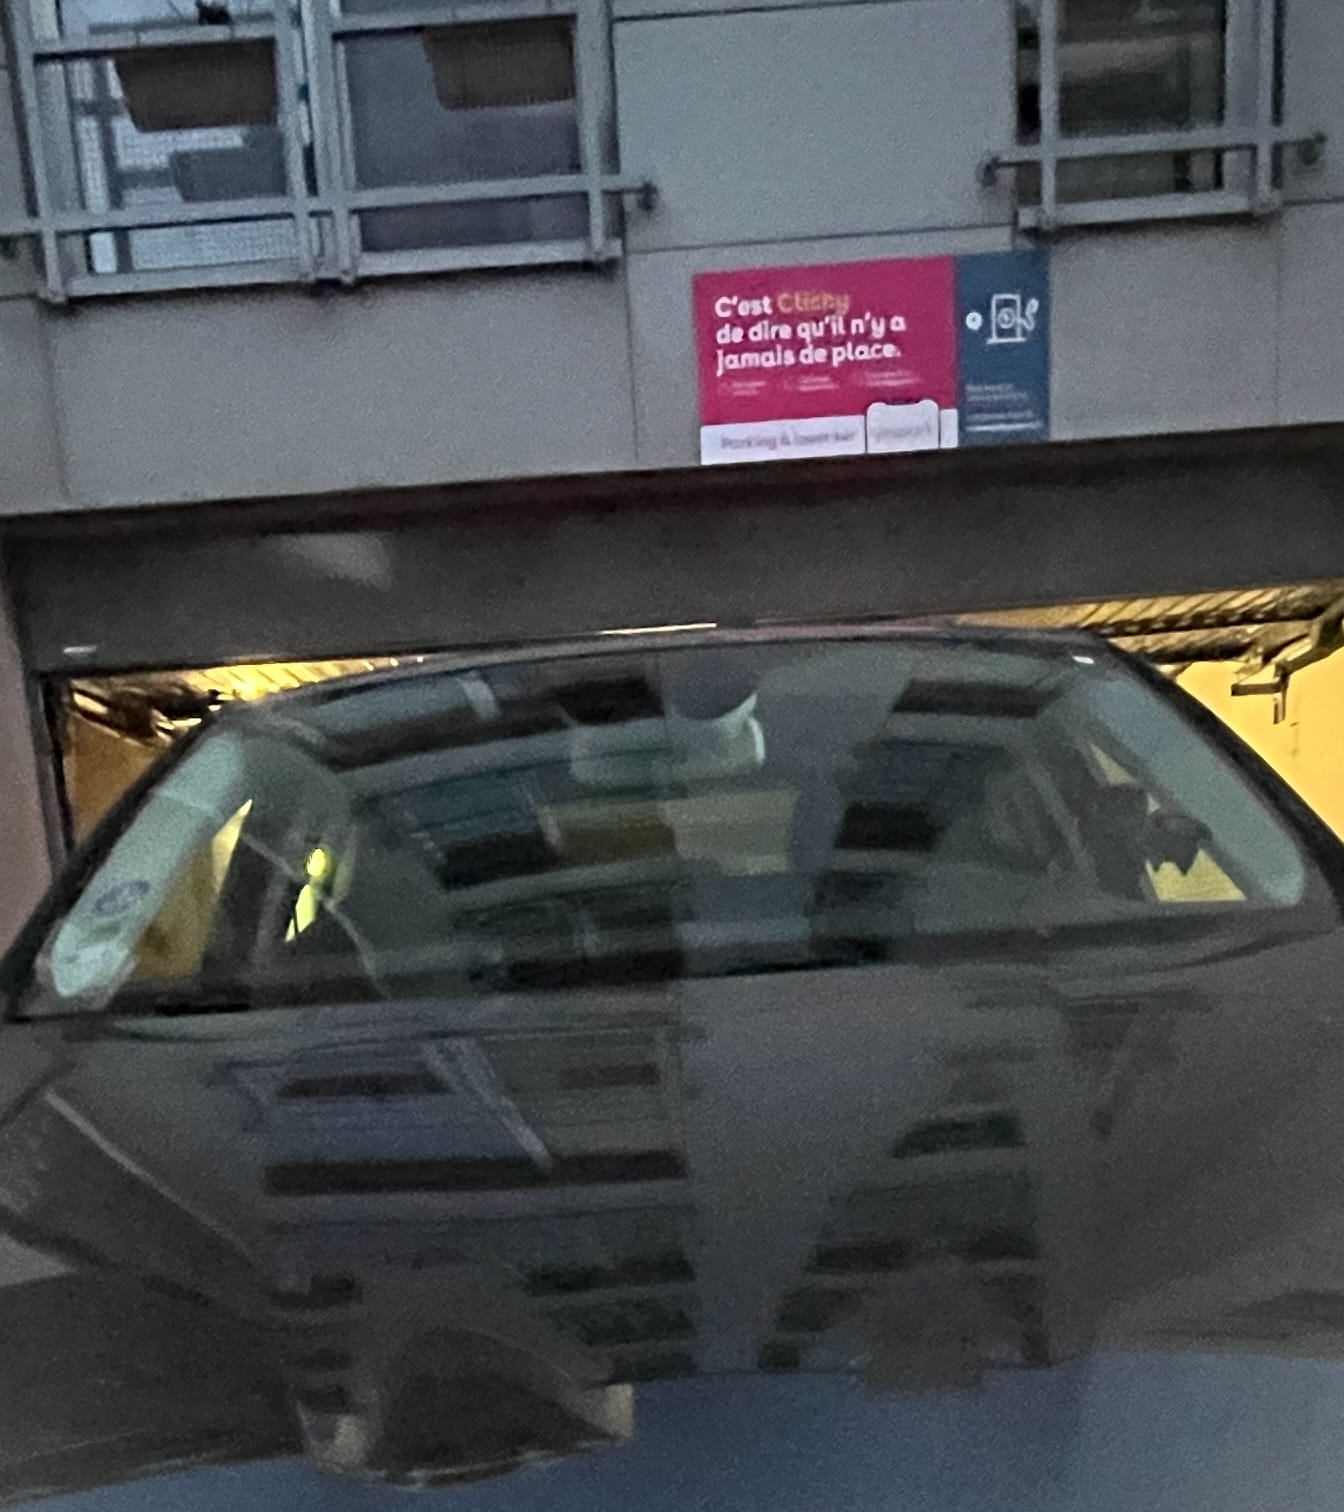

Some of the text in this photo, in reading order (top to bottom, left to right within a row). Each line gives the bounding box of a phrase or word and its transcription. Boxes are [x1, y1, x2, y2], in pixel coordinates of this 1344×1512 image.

[715, 291, 851, 318] C'est Clichy
[716, 311, 908, 345] de dire qu'il n'y a
[716, 341, 903, 377] jamais de place.
